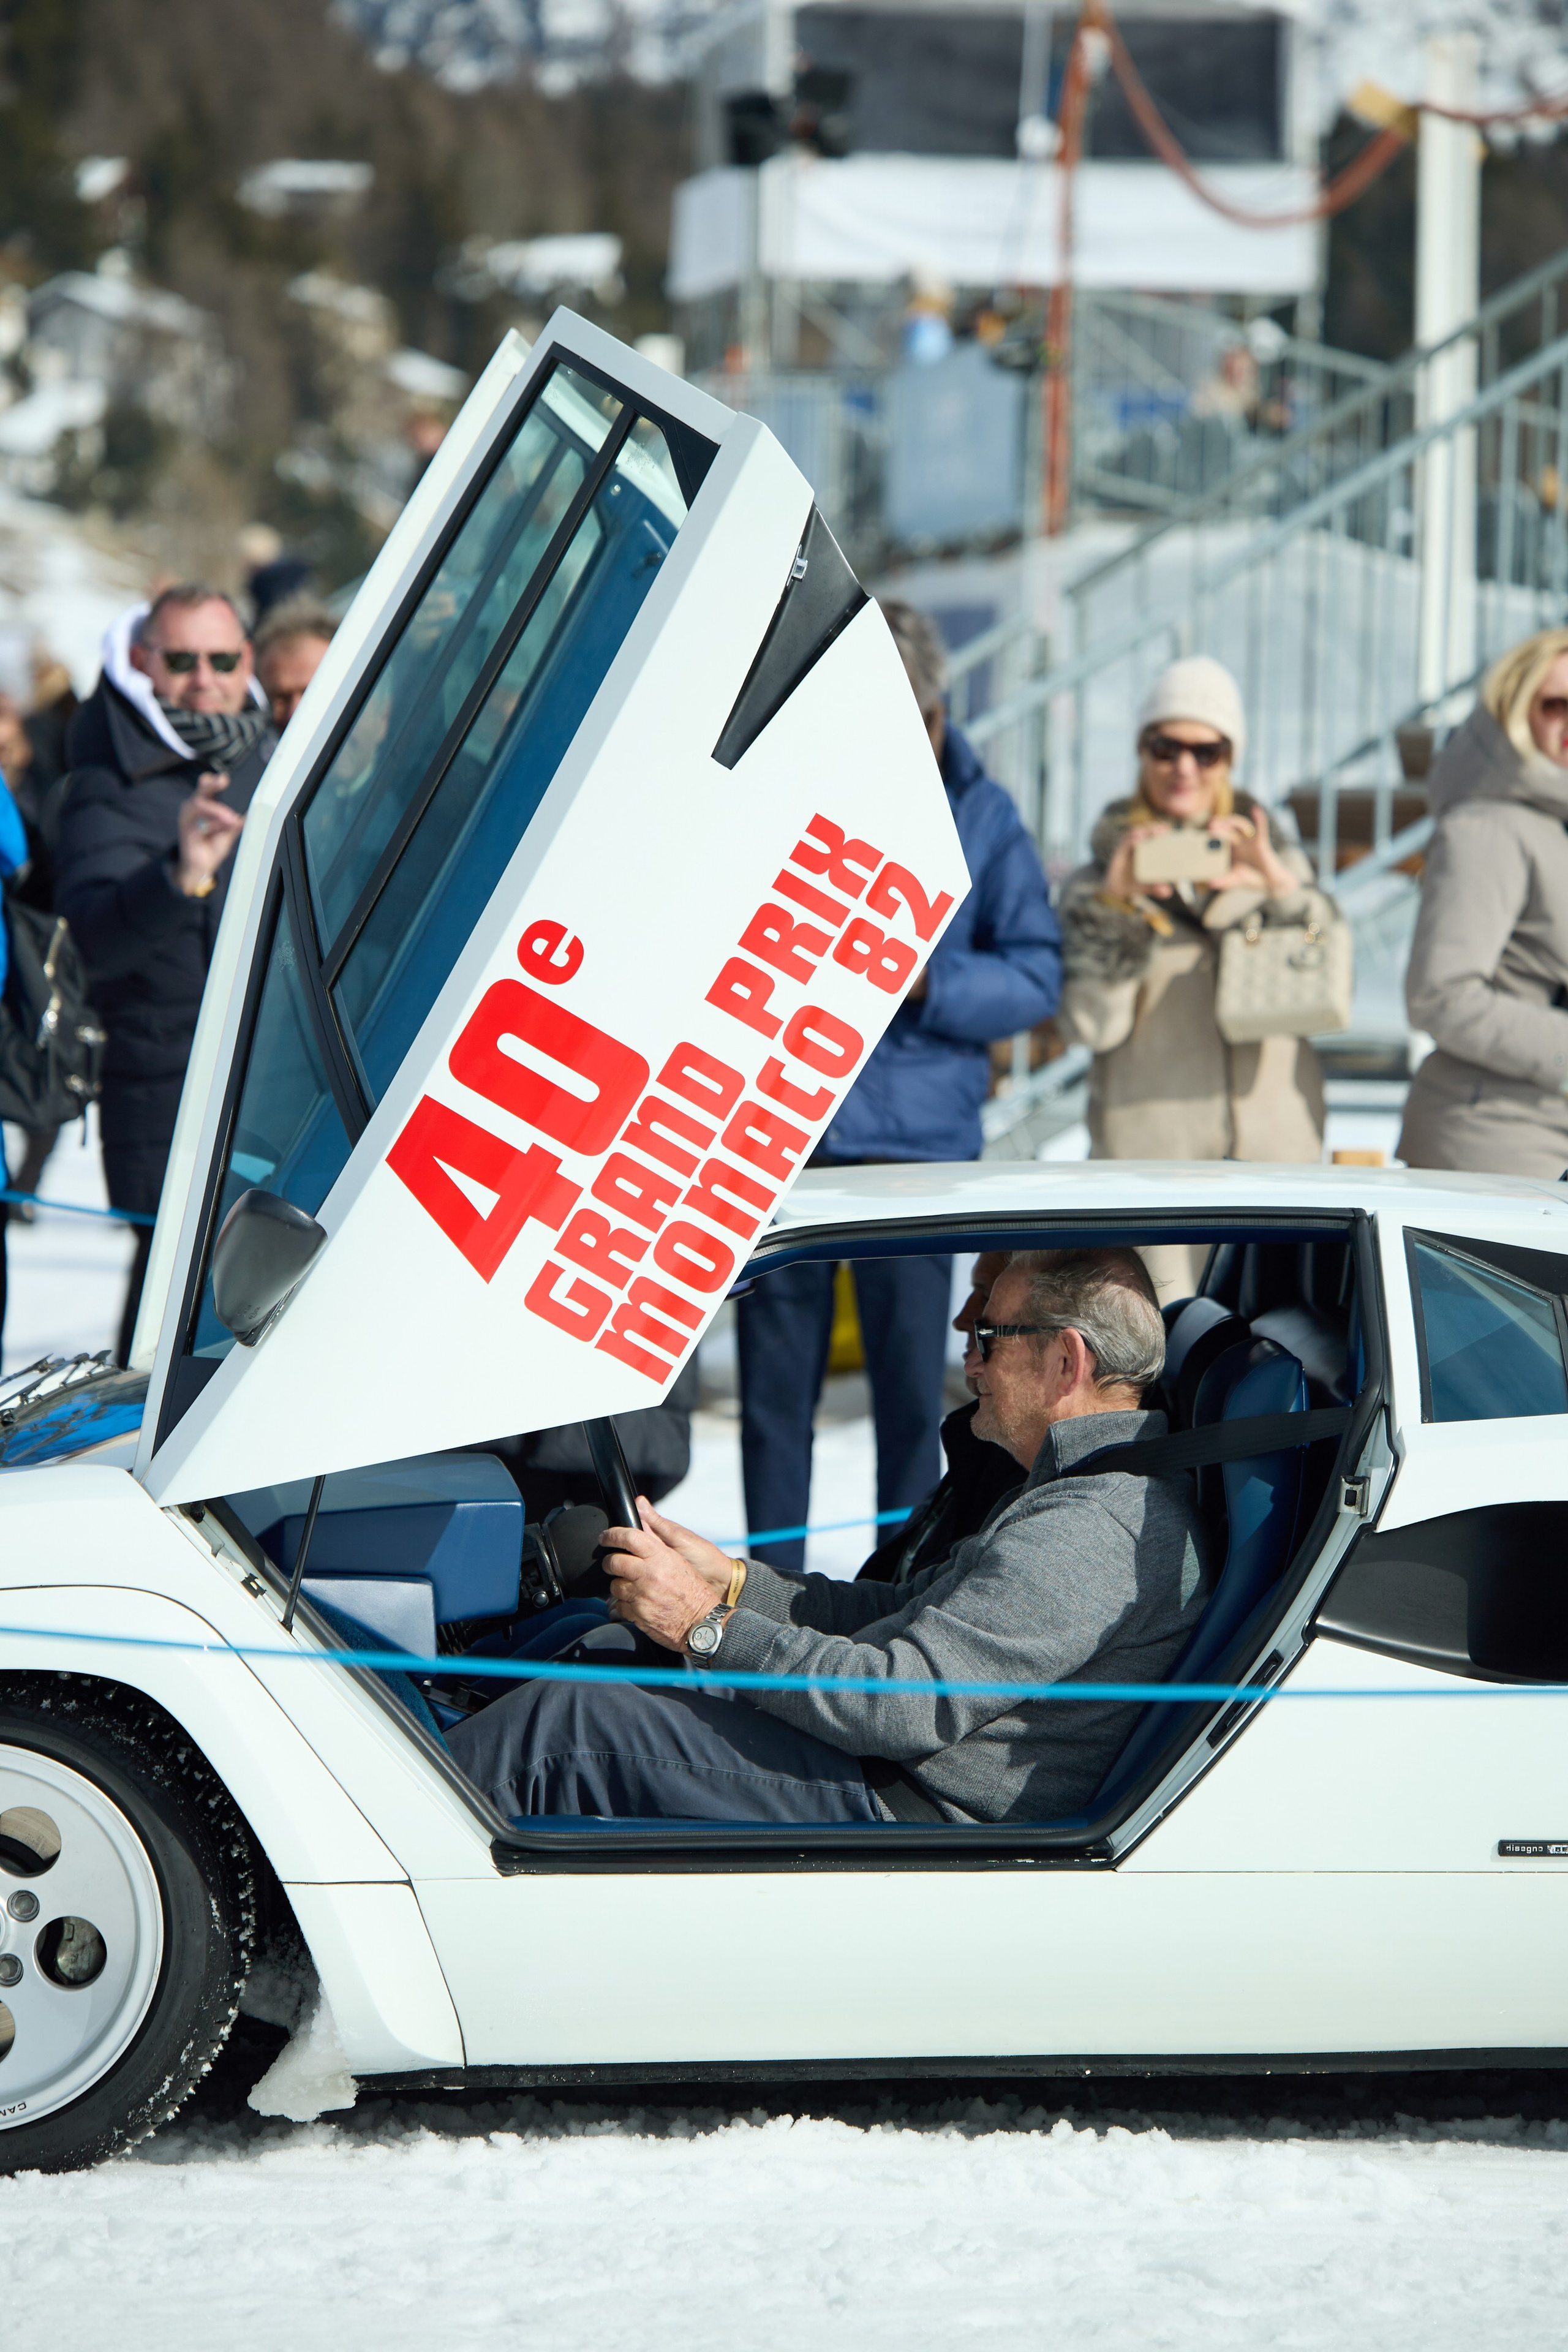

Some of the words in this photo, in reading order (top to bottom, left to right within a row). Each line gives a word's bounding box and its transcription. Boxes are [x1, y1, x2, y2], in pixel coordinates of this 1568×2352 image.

[524, 1042, 745, 1342] GRAND
[705, 813, 884, 1039] PRIX
[595, 1005, 864, 1385] MONACO
[832, 862, 954, 994] 82
[1506, 1844, 1544, 1854] disegno
